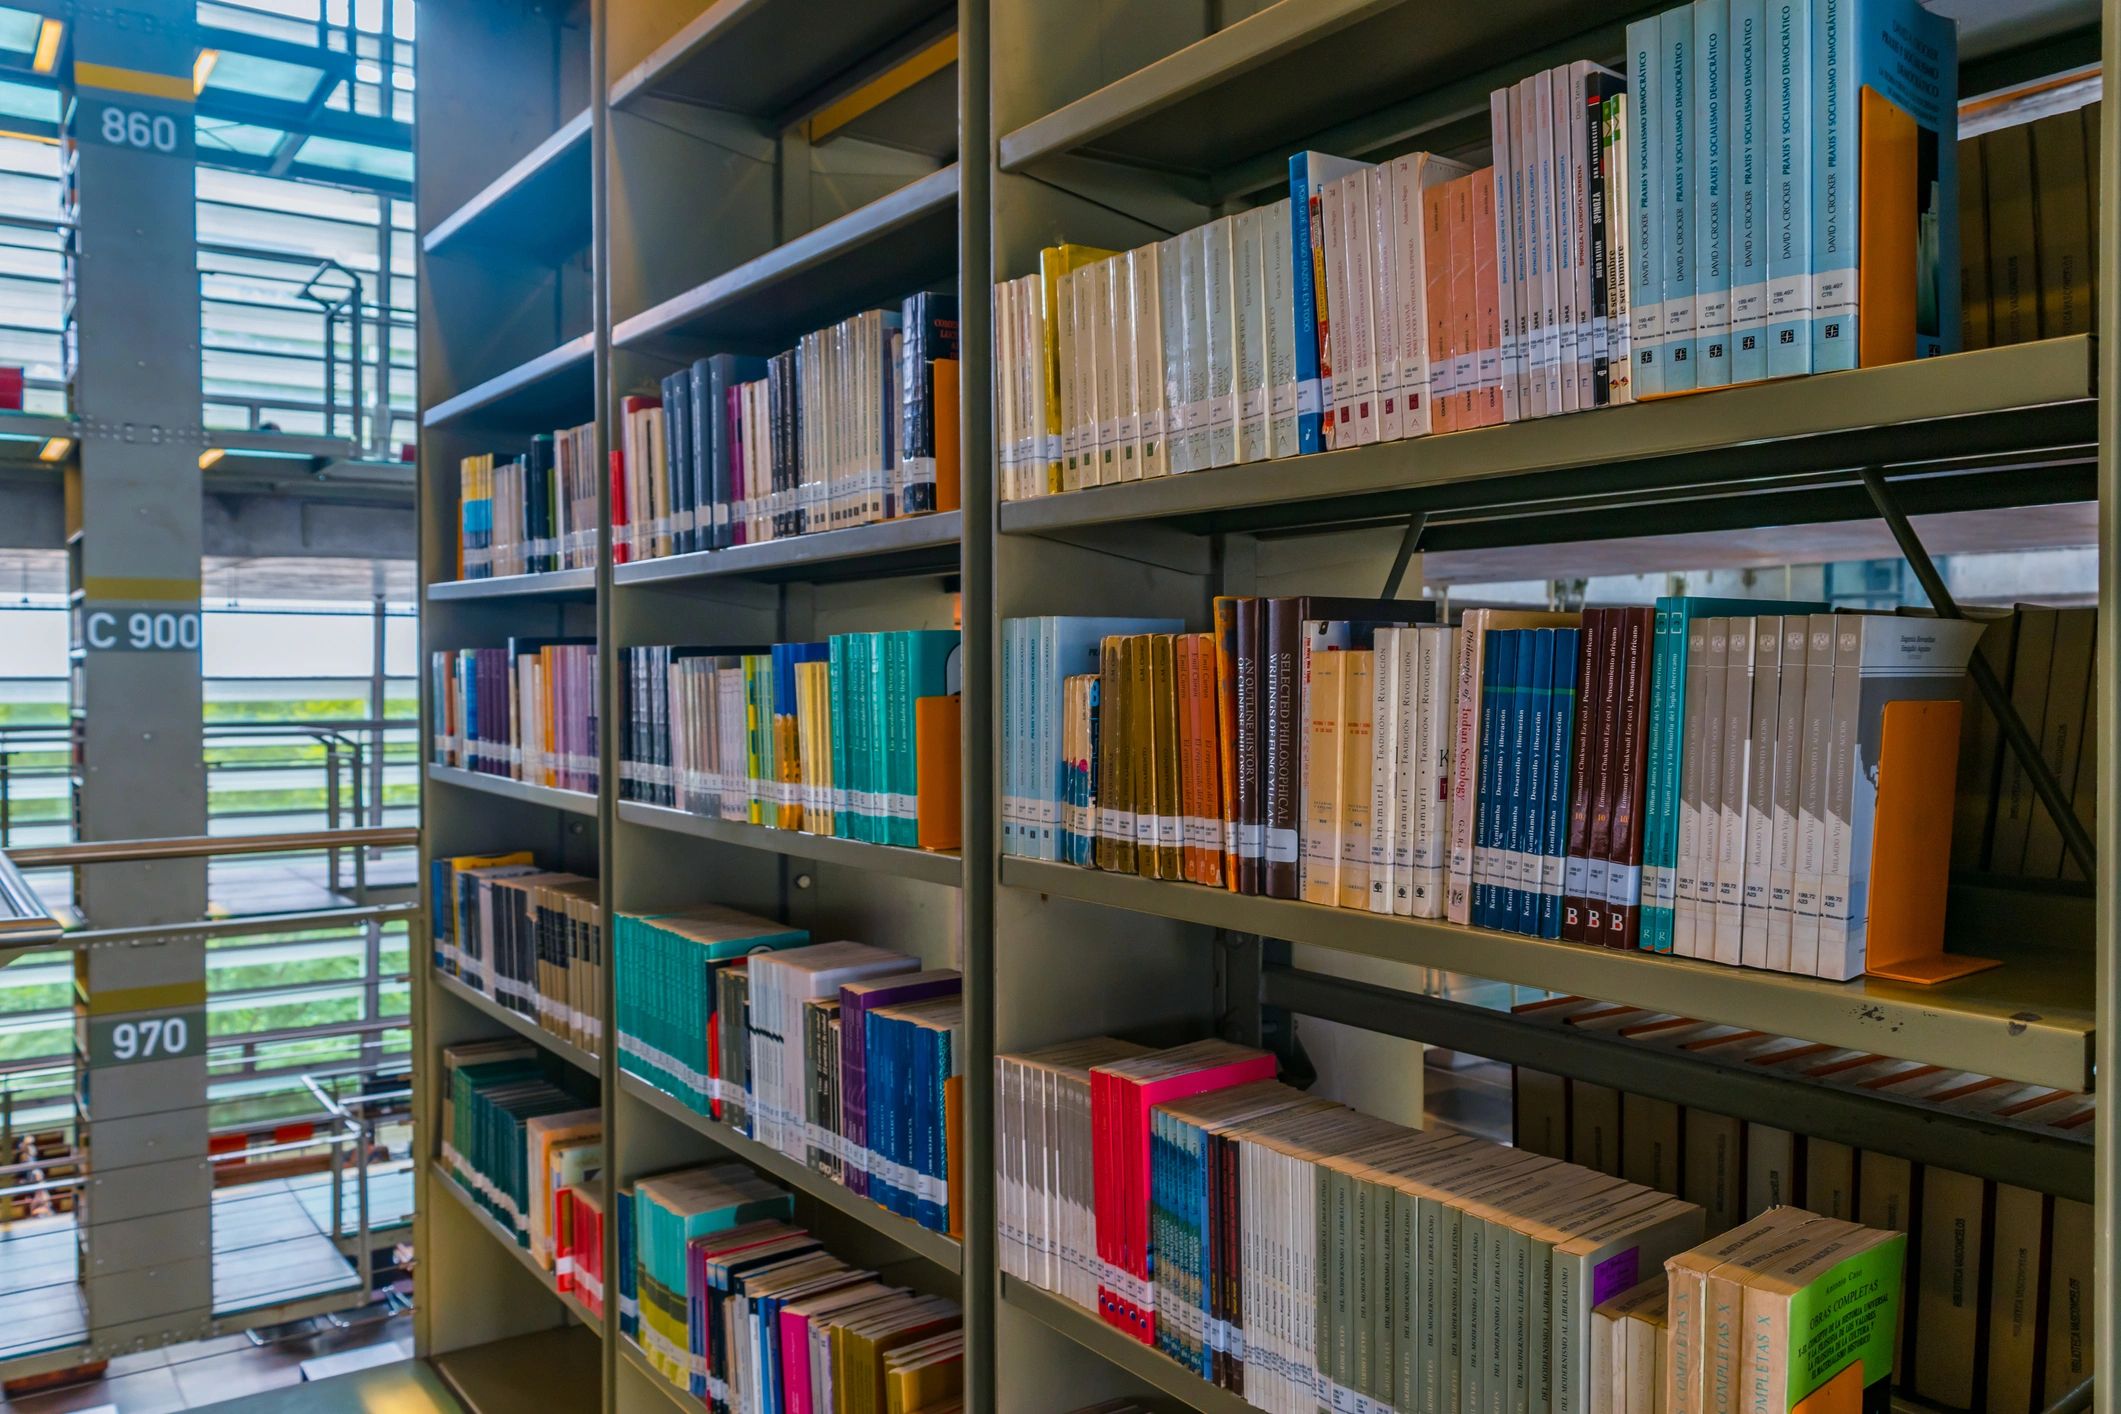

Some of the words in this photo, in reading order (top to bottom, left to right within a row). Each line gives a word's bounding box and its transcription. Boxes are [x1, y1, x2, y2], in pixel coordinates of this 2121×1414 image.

[1742, 18, 1752, 87] DEMOCRÁTICO
[1780, 6, 1790, 75] DEMOCRÁTICO
[1638, 51, 1647, 115] DEMOCRÁTICO
[1673, 42, 1682, 108] DEMOCRÁTICO
[1708, 33, 1717, 100] DEMOCRÁTICO
[1782, 77, 1790, 134] SOCIALISMO
[1828, 68, 1837, 126] SOCIALISMO
[102, 107, 176, 152] 860
[1710, 102, 1718, 156] SOCIALISMO
[1744, 89, 1752, 145] SOCIALISMO
[1640, 117, 1648, 170] SOCIALISMO
[1675, 110, 1683, 163] SOCIALISMO
[1828, 136, 1837, 168] PRAXIS
[1675, 164, 1683, 172] Y
[1710, 158, 1718, 166] Y
[1744, 155, 1752, 185] PRAXIS
[1782, 144, 1790, 175] PRAXIS
[1298, 184, 1306, 203] POR
[1640, 180, 1648, 208] PRAXIS
[1675, 174, 1683, 202] PRAXIS
[1710, 167, 1718, 196] PRAXIS
[1828, 173, 1836, 214] CROCKER
[1593, 192, 1602, 224] SPINOZA
[1744, 190, 1752, 229] CROCKER
[1783, 181, 1791, 221] CROCKER
[1641, 213, 1649, 250] CROCKER
[1676, 208, 1684, 245] CROCKER
[1710, 201, 1719, 240] CROCKER
[1744, 231, 1752, 239] A.
[1783, 222, 1791, 231] A.
[1828, 215, 1836, 224] A.
[1300, 227, 1308, 257] TENGO
[1710, 241, 1719, 249] A.
[1744, 241, 1752, 267] DAVID
[1783, 233, 1791, 259] DAVID
[1828, 226, 1836, 253] DAVID
[1301, 260, 1310, 290] RAZÓN
[1607, 250, 1616, 290] hombre
[1616, 246, 1625, 286] hombre
[1641, 261, 1649, 286] DAVID
[1676, 257, 1684, 281] DAVID
[1710, 251, 1719, 276] DAVID
[1303, 293, 1309, 306] EN
[88, 612, 116, 648] C
[128, 612, 200, 648] 900
[1585, 629, 1593, 657] africano
[1609, 627, 1617, 656] africano
[1630, 626, 1638, 655] africano
[1238, 657, 1245, 674] OF
[1246, 658, 1254, 674] AN
[1462, 630, 1474, 686] Philosophy
[1670, 654, 1678, 690] Americano
[1269, 654, 1277, 715] WRITINGS
[1279, 653, 1290, 718] SELECTED
[1462, 689, 1472, 702] of
[1583, 659, 1592, 702] Pensamiento
[1606, 658, 1615, 702] Pensamiento
[1628, 657, 1637, 702] Pensamiento
[1246, 678, 1254, 729] OUTLINE
[1669, 692, 1677, 708] Siglo
[1269, 719, 1277, 737] OF
[1460, 708, 1472, 744] Indian
[1516, 709, 1524, 748] liberación
[1533, 712, 1541, 751] liberación
[1553, 712, 1562, 751] liberación
[1625, 724, 1633, 735] Eze
[1666, 724, 1675, 751] filosofía
[1245, 732, 1255, 784] HISTORY
[1268, 739, 1276, 774] FUNG
[1578, 737, 1586, 770] Chukwudi
[1601, 738, 1610, 771] Chukwudi
[1623, 738, 1632, 771] Chukwudi
[1277, 721, 1289, 823] PHILOSOPHICAL
[1456, 747, 1470, 800] Sociology
[1513, 756, 1521, 797] Desarrollo
[1530, 760, 1538, 800] Desarrollo
[1551, 760, 1560, 801] Desarrollo
[1576, 772, 1584, 806] Emmanuel
[1599, 772, 1607, 807] Emmanuel
[1267, 778, 1275, 828] YU-LAN
[1620, 773, 1629, 809] Emmanuel
[1510, 806, 1519, 849] Kamilamba
[1527, 809, 1536, 853] Kamilamba
[1548, 811, 1557, 854] Kamilamba
[113, 1017, 187, 1059] 970
[1561, 1268, 1569, 1323] LIBERALISMO
[1810, 1303, 1831, 1330] OBRAS
[1833, 1280, 1879, 1312] COMPLETAS
[1561, 1325, 1568, 1335] AL
[1561, 1337, 1569, 1395] MODERNISMO
